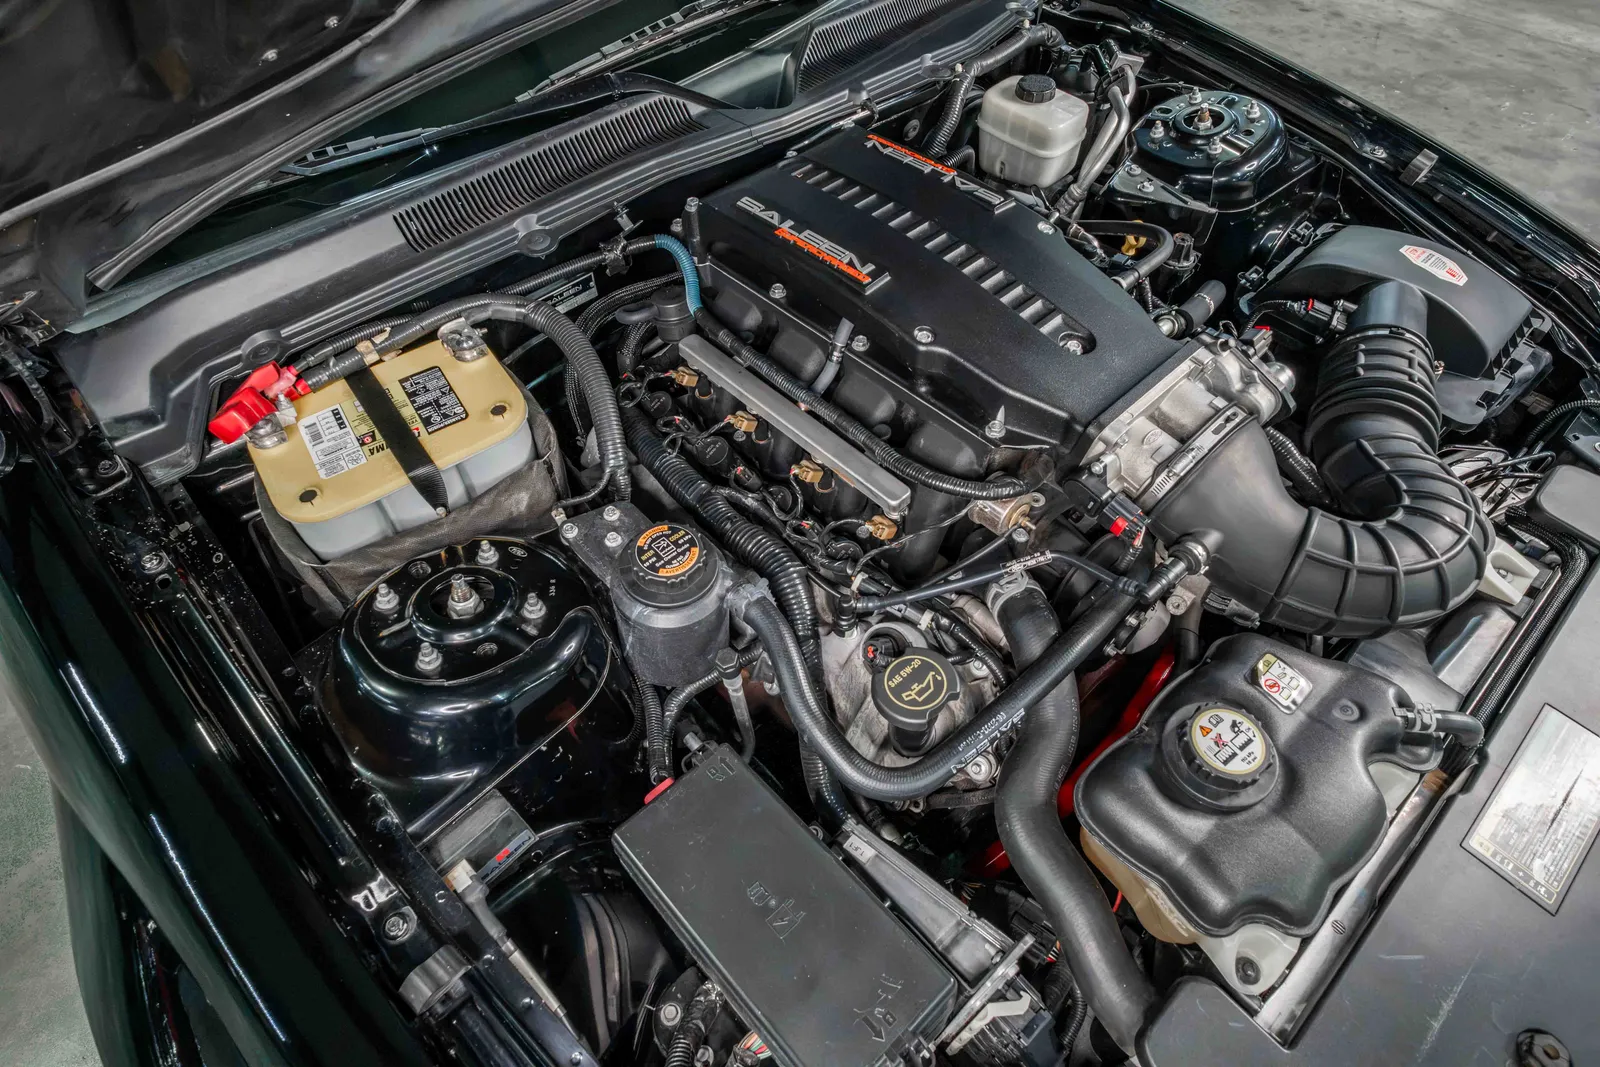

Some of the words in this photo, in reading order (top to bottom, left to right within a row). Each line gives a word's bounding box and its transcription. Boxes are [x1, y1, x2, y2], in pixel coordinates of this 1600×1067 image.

[864, 139, 1004, 205] SALEEN
[736, 196, 876, 273] SALEEN
[640, 549, 655, 560] INTER
[669, 530, 686, 542] COOLER
[642, 526, 666, 541] WARNING
[664, 551, 678, 561] Owner
[677, 543, 690, 553] Guide
[665, 550, 698, 574] AVERTISSEMENT
[888, 674, 903, 688] SAE
[900, 658, 922, 678] 5W-20
[951, 707, 1026, 775] SALEEN
[480, 836, 532, 881] SALEEN
